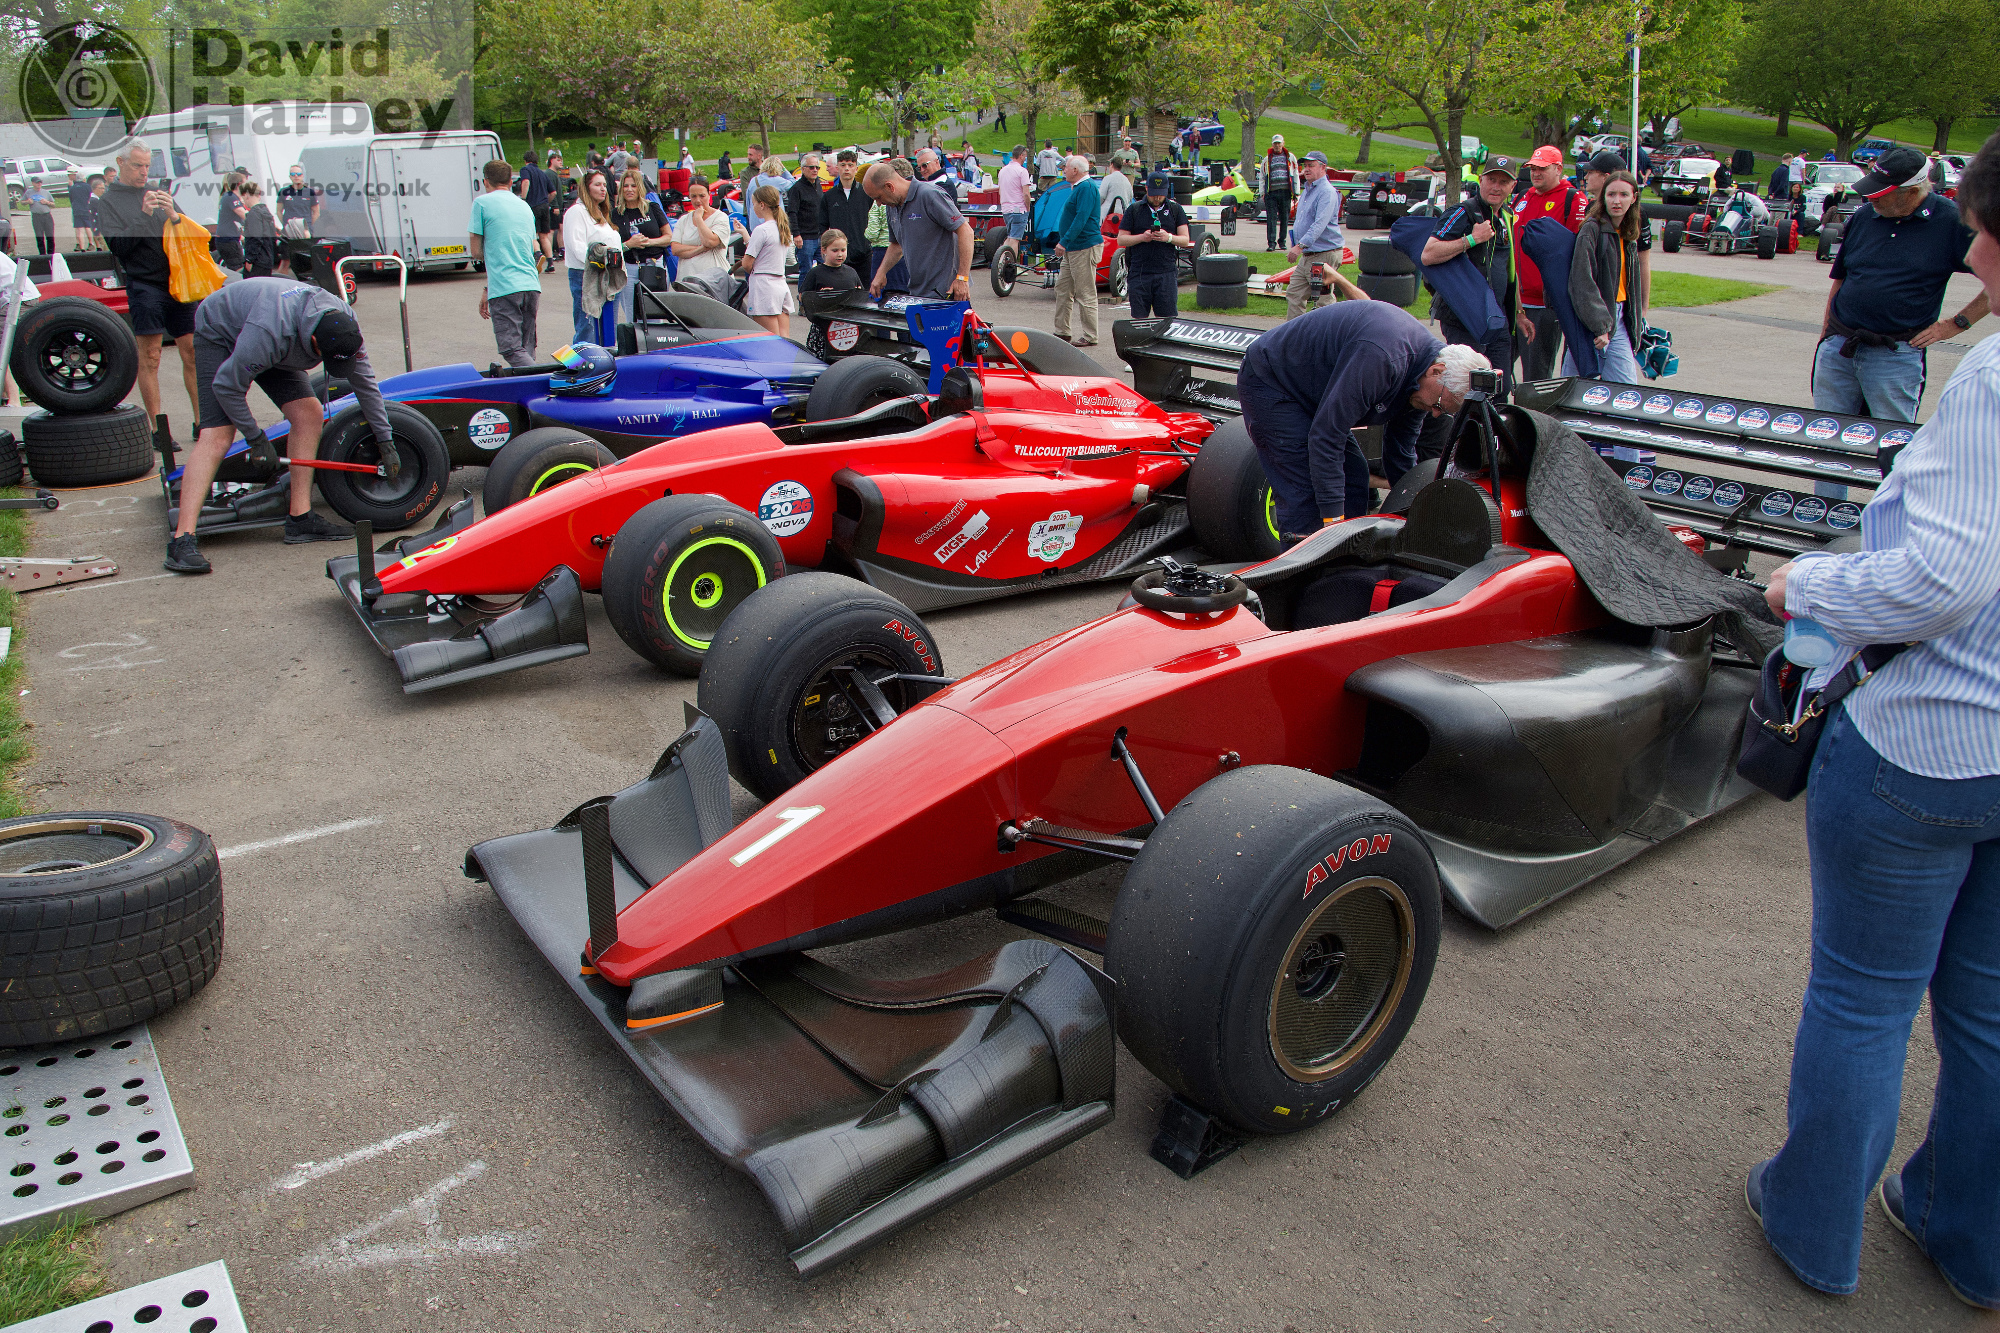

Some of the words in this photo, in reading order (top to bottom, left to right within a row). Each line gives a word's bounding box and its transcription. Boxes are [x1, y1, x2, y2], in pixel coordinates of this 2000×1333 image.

[343, 272, 357, 294] 6
[24, 313, 56, 345] AVON
[834, 327, 858, 340] 2026
[1061, 379, 1080, 400] New
[617, 413, 661, 426] VANITY
[692, 408, 721, 420] HALL
[477, 423, 510, 436] 2026
[480, 436, 506, 445] NOVA
[1014, 444, 1079, 457] TILLICOULTRY
[405, 480, 440, 520] AVON
[771, 498, 812, 518] 2026
[773, 517, 806, 530] NOVA
[914, 498, 968, 545] COSWORTH
[399, 536, 459, 570] 2
[938, 532, 969, 560] MGR
[964, 549, 989, 575] LAP
[641, 541, 670, 630] ZERO
[653, 637, 676, 651] P
[882, 618, 936, 673] AVON
[728, 804, 826, 868] 1
[1302, 833, 1392, 900] AVON
